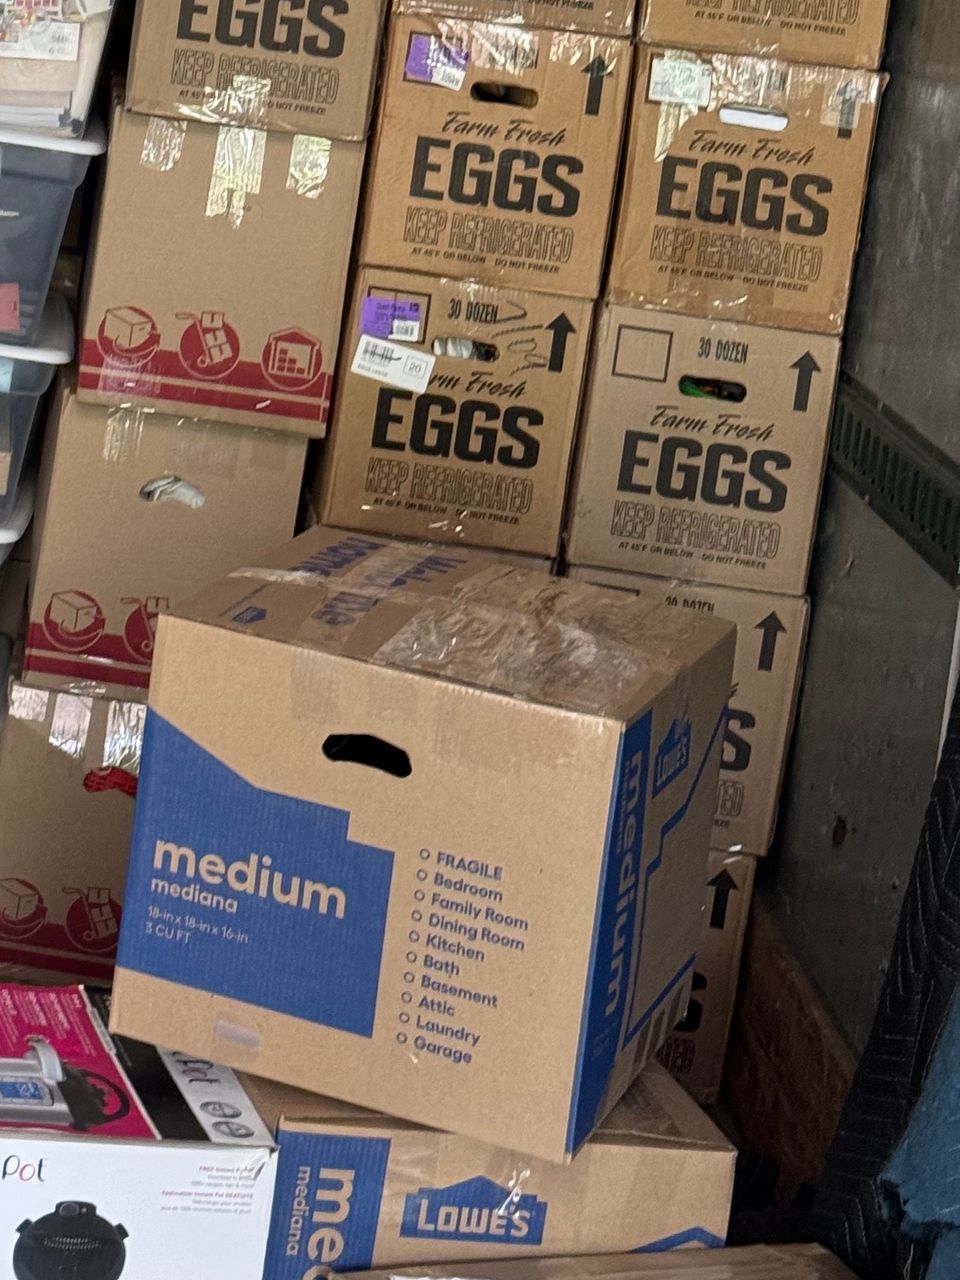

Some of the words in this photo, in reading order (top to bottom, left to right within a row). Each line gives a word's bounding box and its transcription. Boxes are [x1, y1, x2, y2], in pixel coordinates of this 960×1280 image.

[170, 48, 214, 85] KEEP
[440, 110, 500, 139] Farm
[503, 119, 567, 147] Fresh
[689, 129, 747, 158] Farm
[751, 138, 816, 166] Fresh
[409, 135, 583, 218] EGGS
[656, 155, 833, 237] EGGS
[403, 205, 448, 246] KEEP
[448, 211, 574, 264] REFRIGERATED
[456, 252, 487, 265] BELOW
[649, 224, 694, 262] KEEP
[695, 231, 823, 281] REFRIGERATED
[703, 269, 735, 283] BELOW
[448, 299, 462, 320] 30
[465, 302, 499, 324] DOZEN
[697, 337, 711, 359] 30
[714, 339, 749, 365] DOZEN
[465, 371, 527, 399] Fresh
[371, 387, 544, 469] EGGS
[649, 405, 708, 433] Farm
[712, 414, 777, 442] Fresh
[365, 457, 409, 494] KEEP
[409, 464, 534, 515] REFRIGERATED
[617, 429, 792, 514] EGGS
[418, 502, 447, 515] BELOW
[611, 500, 655, 540] KEEP
[656, 506, 780, 559] REFRIGERATED
[663, 547, 694, 560] BELOW
[716, 554, 733, 566] NOT
[153, 839, 347, 920] medium
[436, 851, 503, 881] FRAGILE
[151, 878, 239, 914] mediana
[433, 872, 503, 904] Bedroom
[604, 750, 643, 1018] medium
[431, 892, 481, 920] Family
[485, 907, 529, 931] Room
[145, 922, 153, 934] 3
[155, 925, 175, 940] CU
[176, 931, 191, 944] FT
[425, 933, 485, 962] Kitchen
[428, 913, 478, 941] Dining
[481, 927, 525, 951] Room
[423, 954, 460, 976] Bath
[418, 995, 455, 1017] Attic
[421, 974, 498, 1009] Basement
[415, 1015, 481, 1048] Laundry
[413, 1035, 473, 1064] Garage
[1, 1155, 46, 1183] Pot
[285, 1165, 311, 1256] mediana
